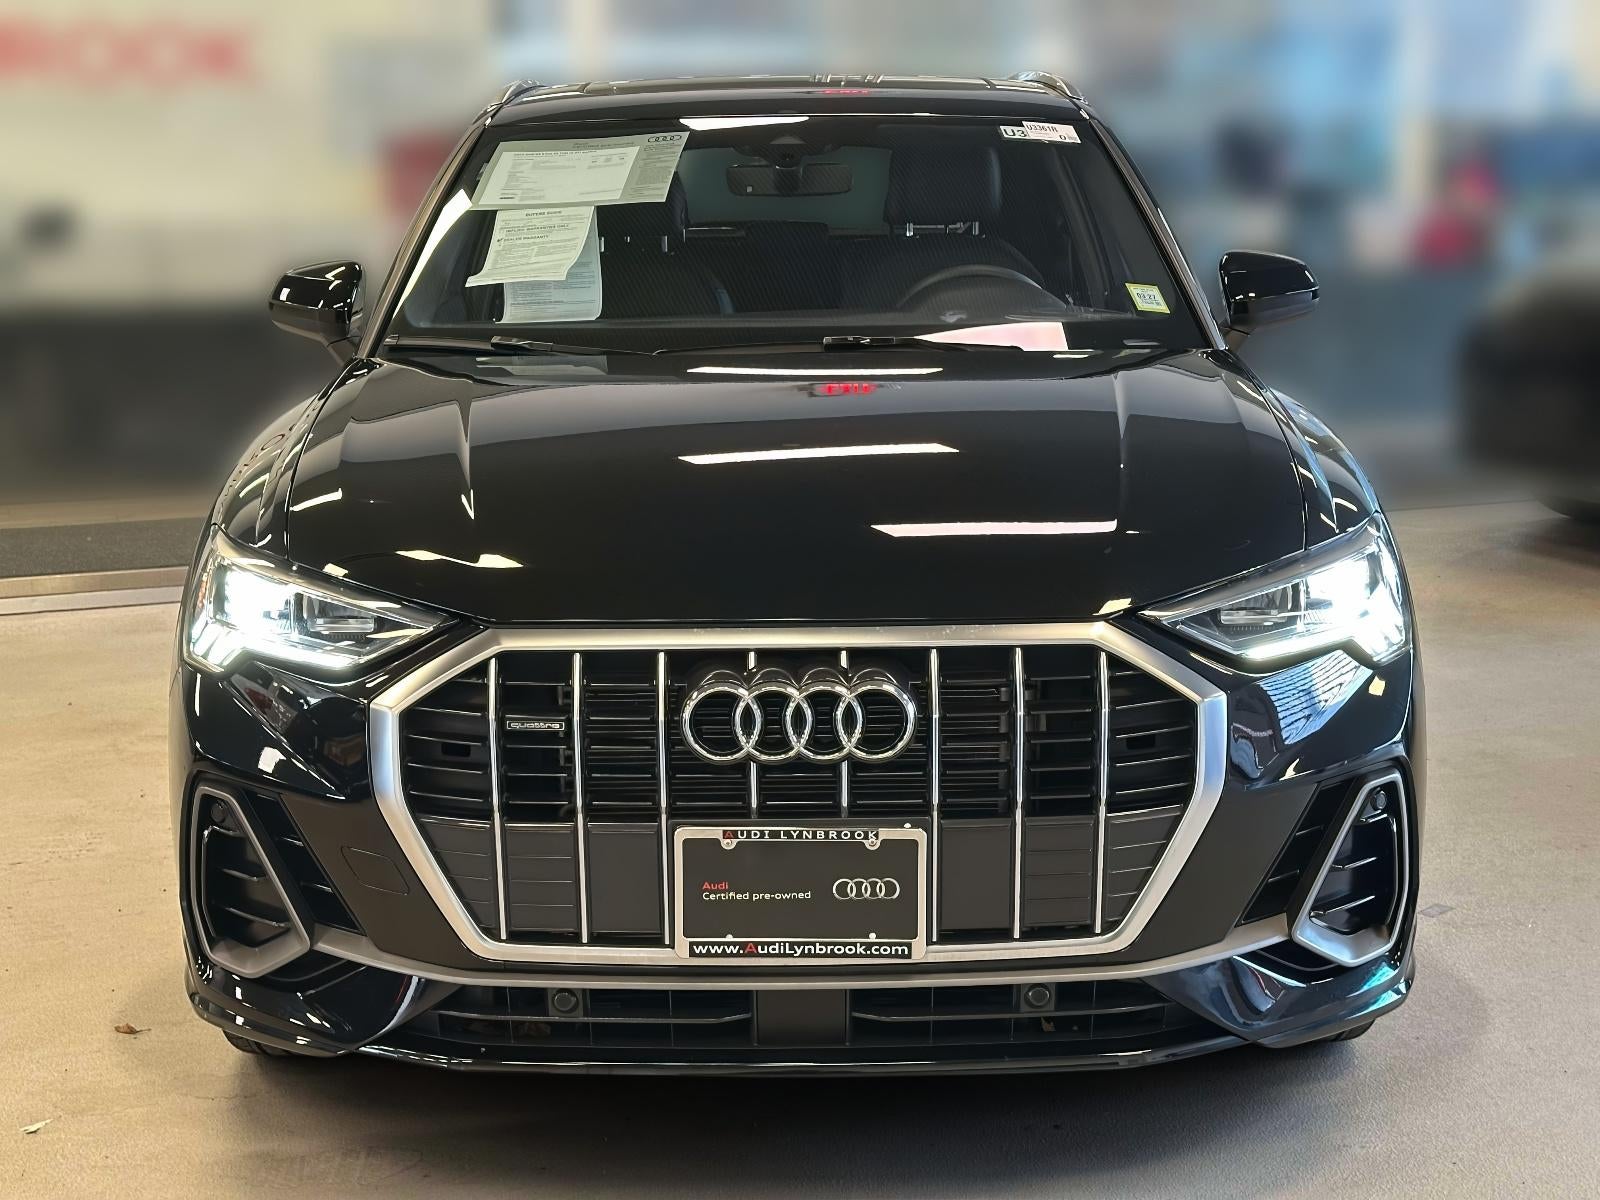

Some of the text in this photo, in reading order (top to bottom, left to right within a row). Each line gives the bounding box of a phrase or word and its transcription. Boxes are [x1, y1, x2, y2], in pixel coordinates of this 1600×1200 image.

[724, 830, 877, 840] AUDI LYNBROOK
[702, 881, 729, 890] Audi
[702, 890, 811, 903] Certified pre-owned
[693, 942, 909, 957] www.AudiLynbrook.com
